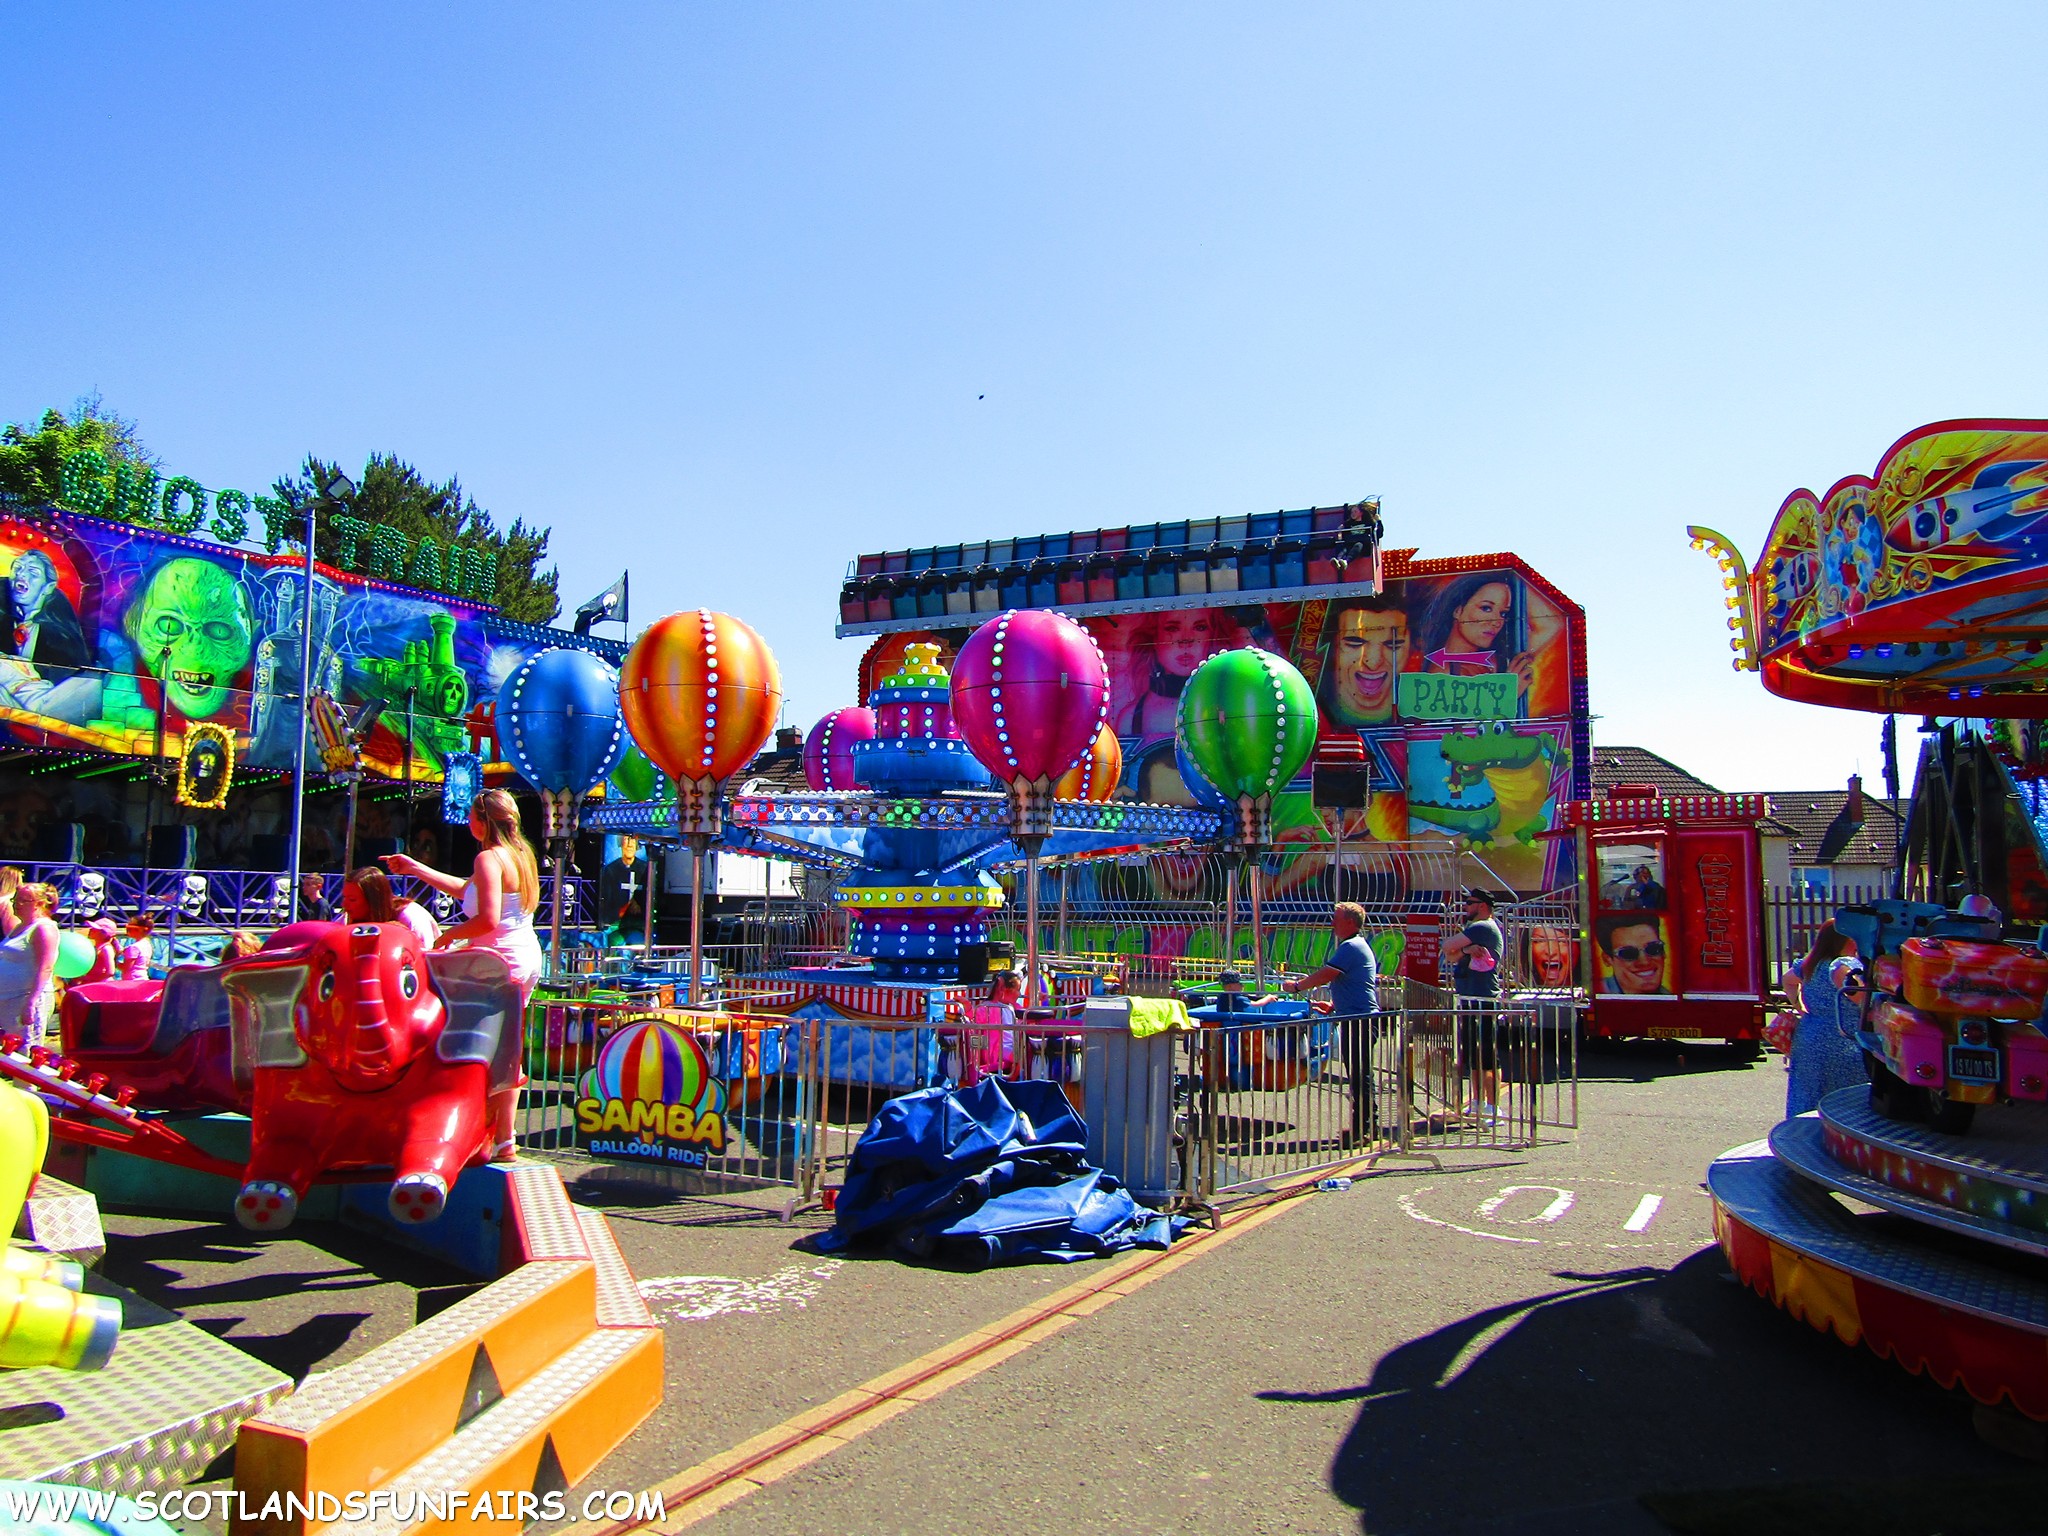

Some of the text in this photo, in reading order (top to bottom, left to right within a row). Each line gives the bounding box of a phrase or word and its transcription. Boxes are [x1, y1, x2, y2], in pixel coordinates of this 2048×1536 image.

[60, 449, 498, 600] GHOST TRAIN
[1414, 679, 1506, 715] PARTY
[1698, 854, 1733, 966] ADRENALINE
[578, 1098, 723, 1149] SAMBA
[590, 1140, 706, 1165] BALLOON RIDE
